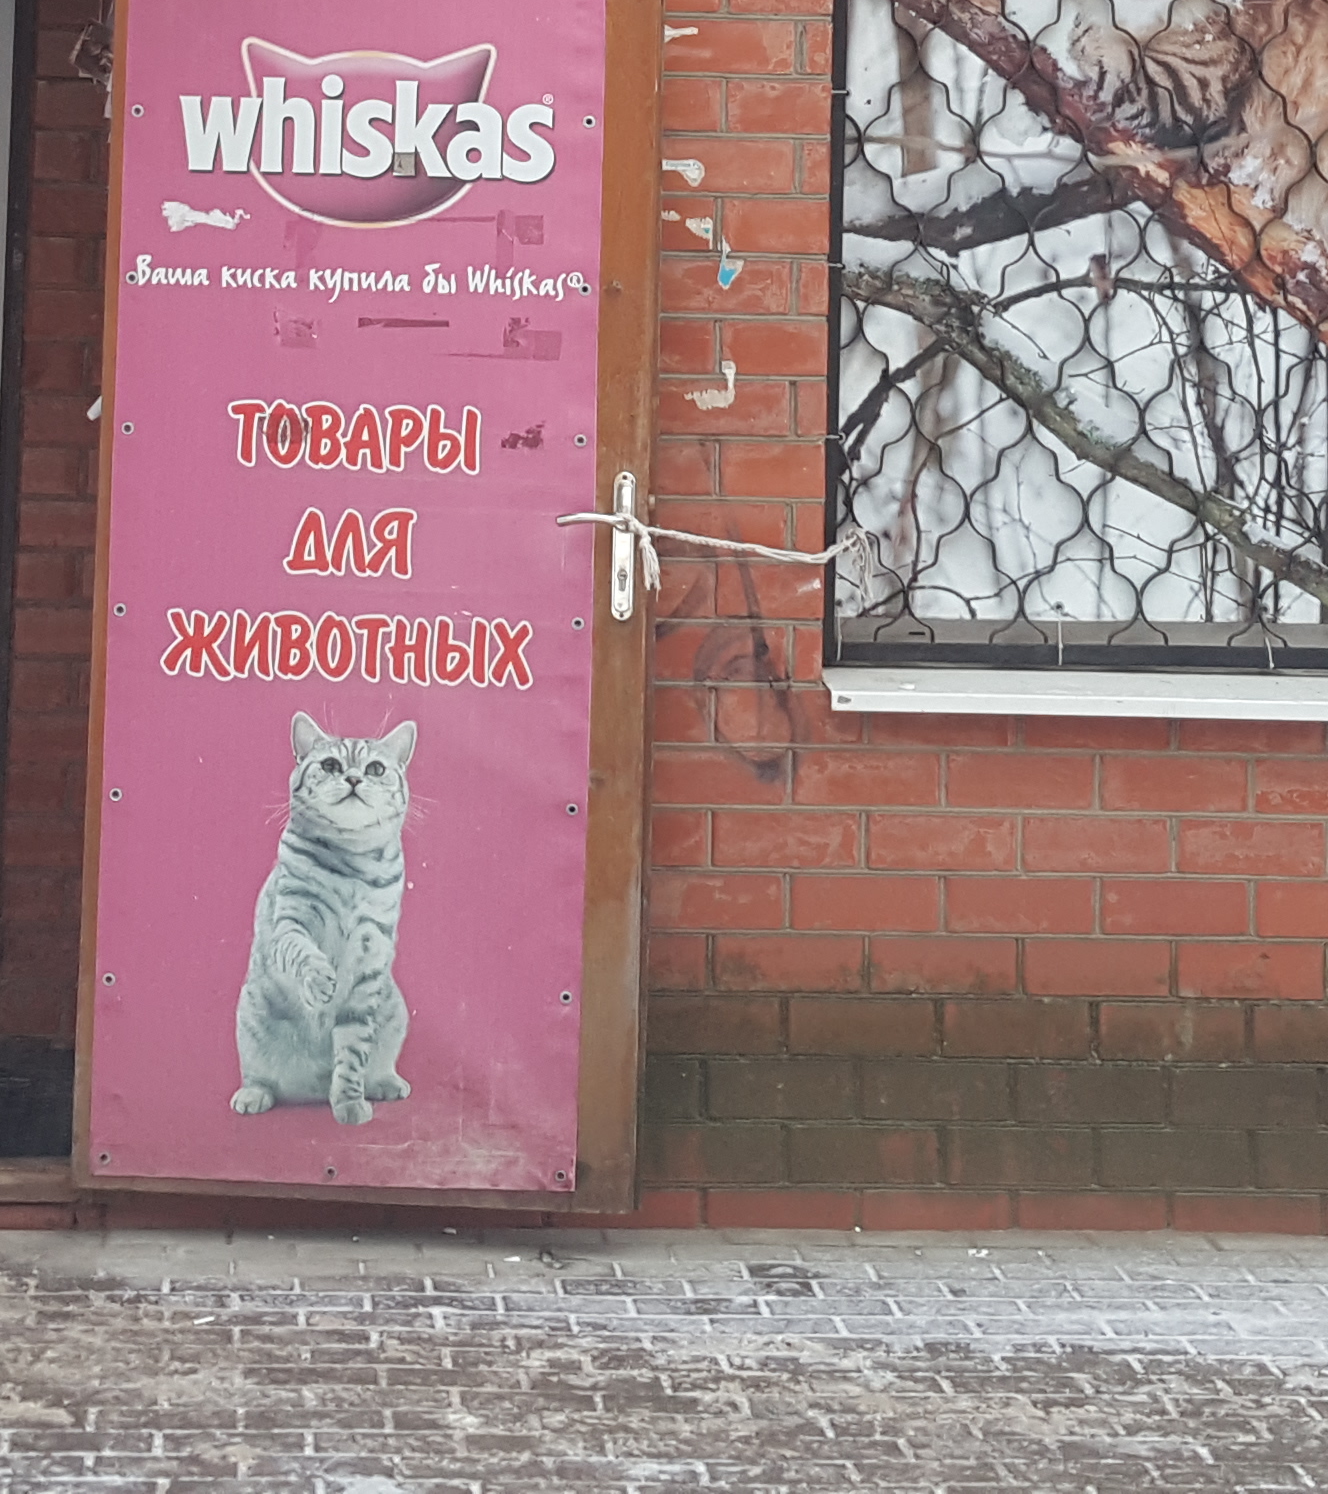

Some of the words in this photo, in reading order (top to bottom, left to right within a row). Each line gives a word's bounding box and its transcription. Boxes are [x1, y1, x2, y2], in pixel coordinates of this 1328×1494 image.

[135, 254, 210, 287] Ваша
[221, 265, 298, 290] киска
[308, 266, 412, 303] купила
[422, 262, 457, 296] бы
[227, 398, 481, 475] ТОВАРЫ
[283, 507, 418, 579] ДЛЯ
[160, 608, 534, 690] ЖИВОТНЫХ
